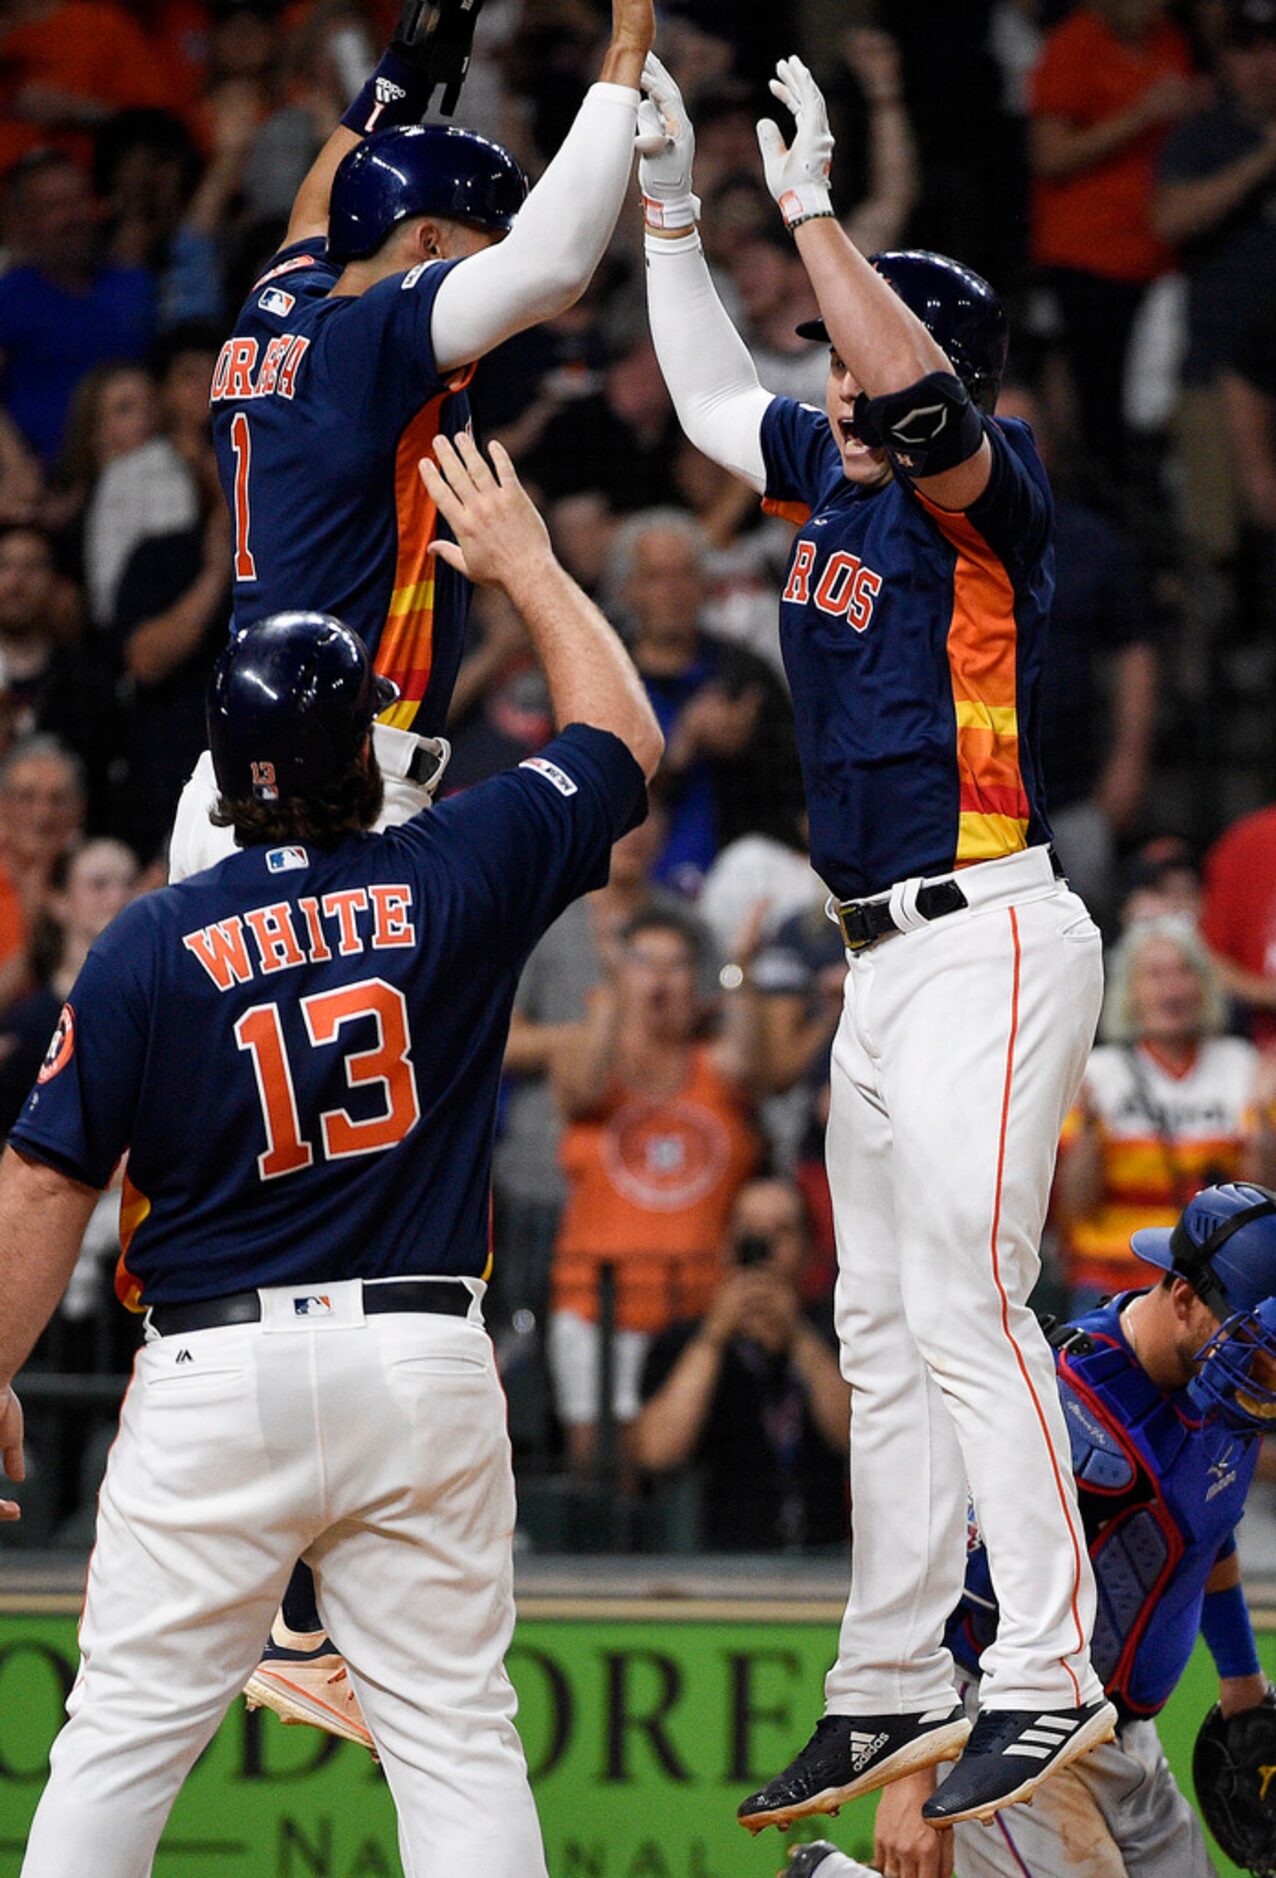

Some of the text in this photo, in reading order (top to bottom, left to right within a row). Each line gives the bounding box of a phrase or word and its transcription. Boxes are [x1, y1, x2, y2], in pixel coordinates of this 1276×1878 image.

[364, 101, 385, 133] 1
[231, 412, 257, 582] 1
[250, 761, 276, 785] 13
[182, 884, 416, 992] WHITE
[233, 977, 420, 1181] 13
[852, 1731, 890, 1773] adidas
